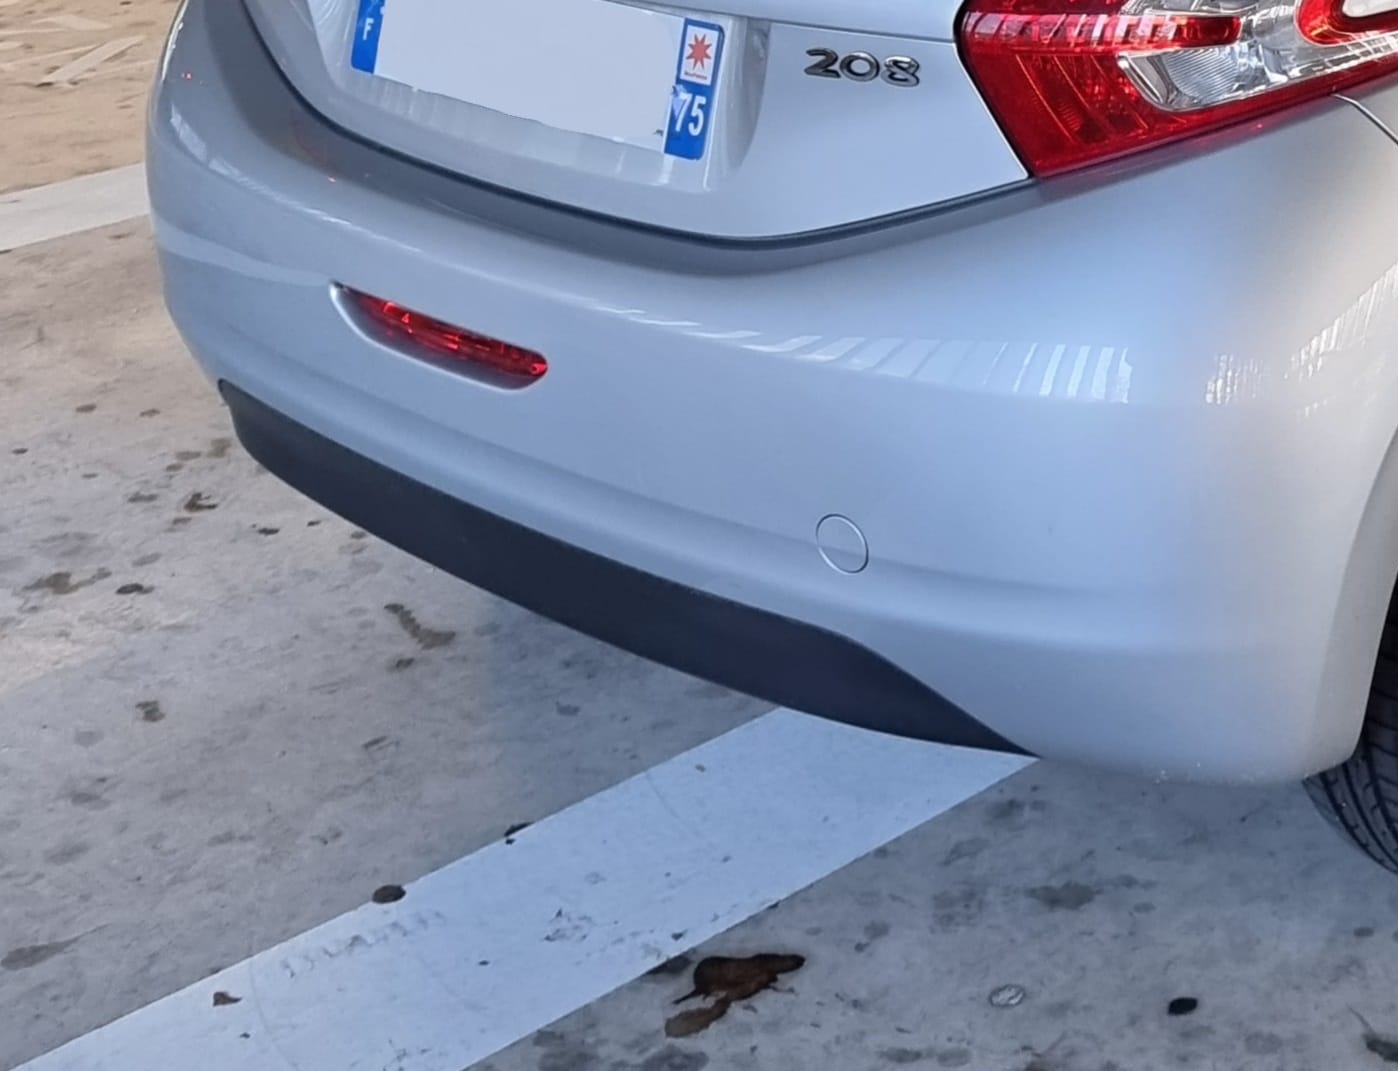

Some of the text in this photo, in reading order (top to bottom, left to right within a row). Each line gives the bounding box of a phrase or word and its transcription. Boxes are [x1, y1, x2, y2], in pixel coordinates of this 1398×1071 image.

[363, 17, 375, 40] F
[803, 47, 920, 88] 208
[675, 90, 707, 137] 75
